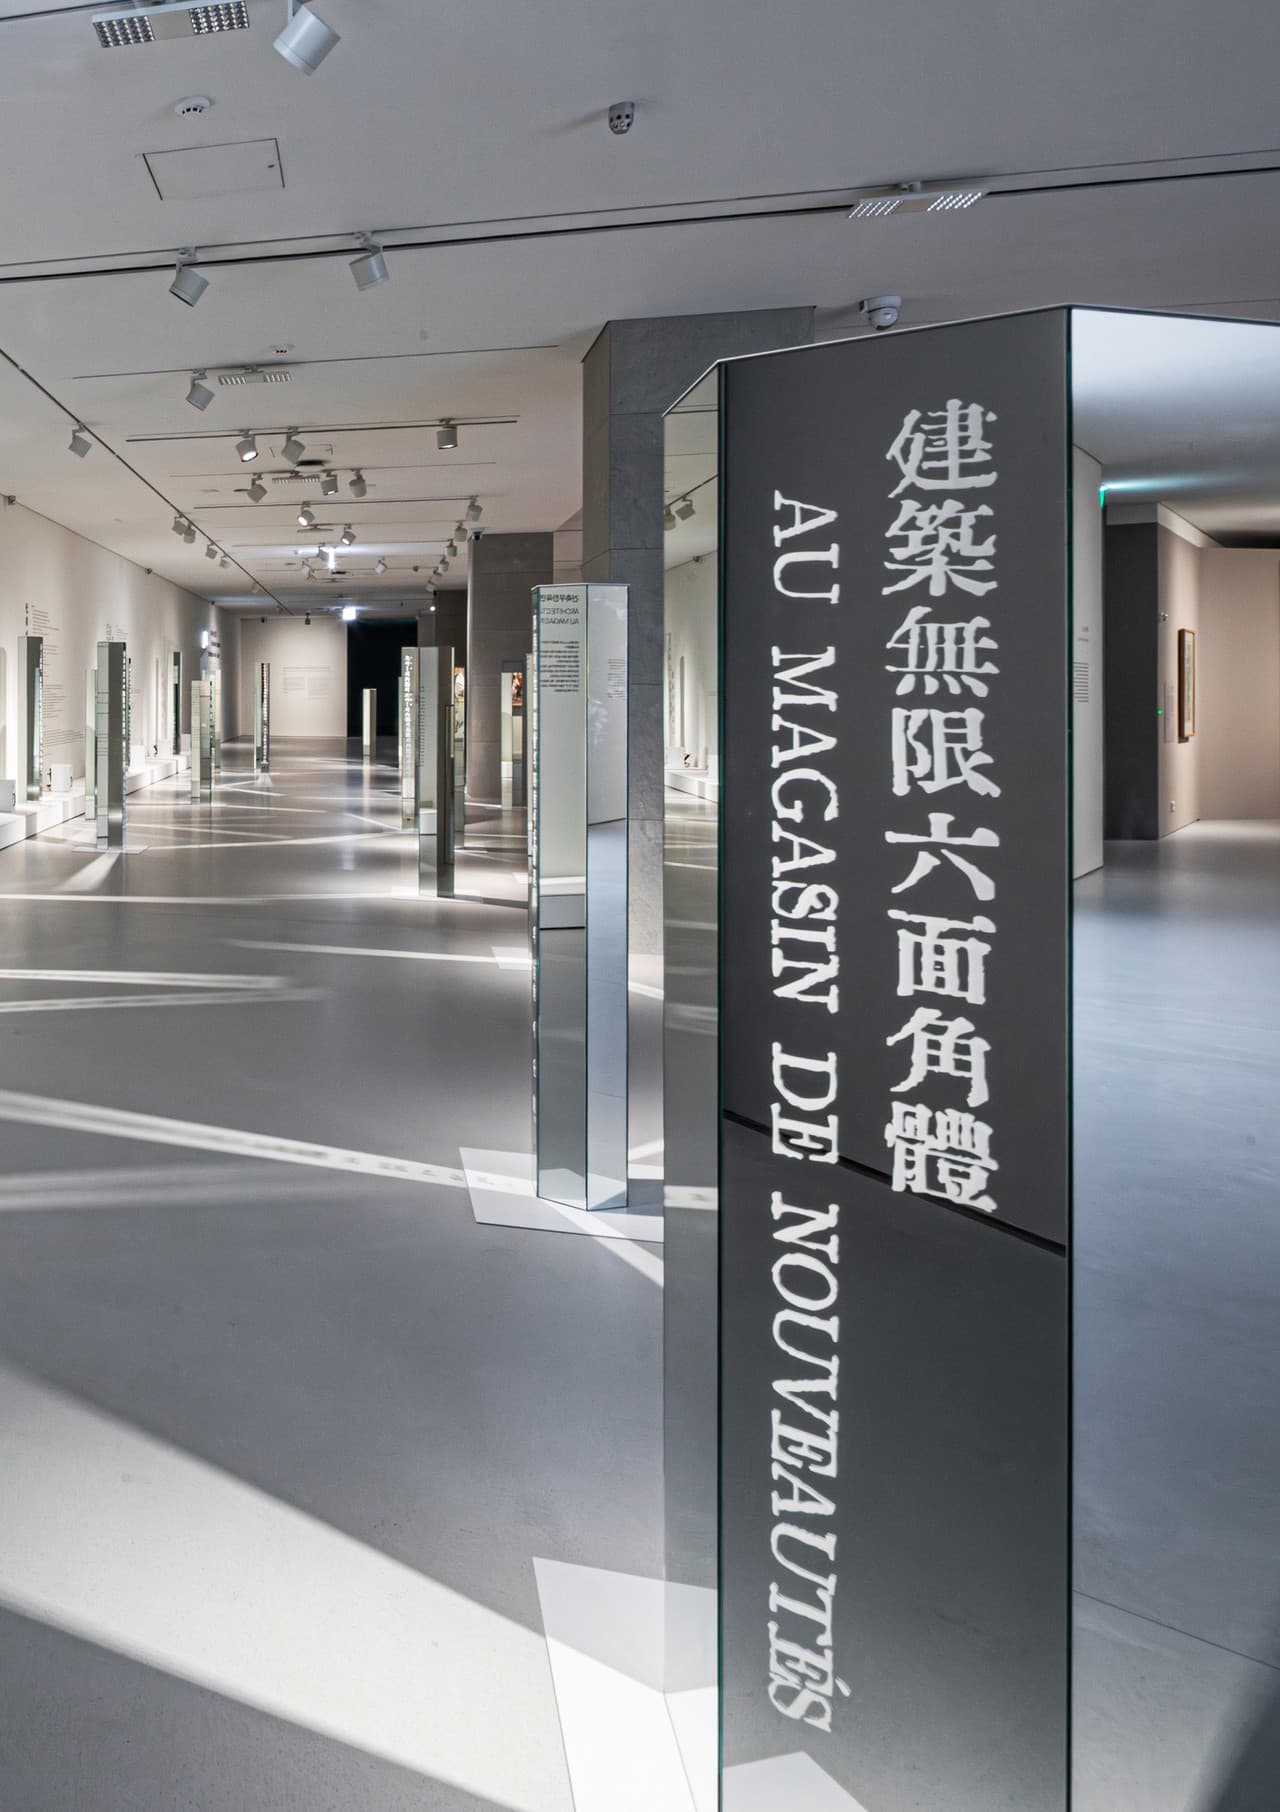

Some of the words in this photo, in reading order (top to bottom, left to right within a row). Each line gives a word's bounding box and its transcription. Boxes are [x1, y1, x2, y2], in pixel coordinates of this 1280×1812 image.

[774, 490, 839, 604] AU
[771, 646, 839, 1013] MAGASIN
[882, 399, 1000, 1212] 建築無限六面角體
[771, 1042, 838, 1164] DE
[769, 1191, 851, 1733] NOUVEAUTÉS
